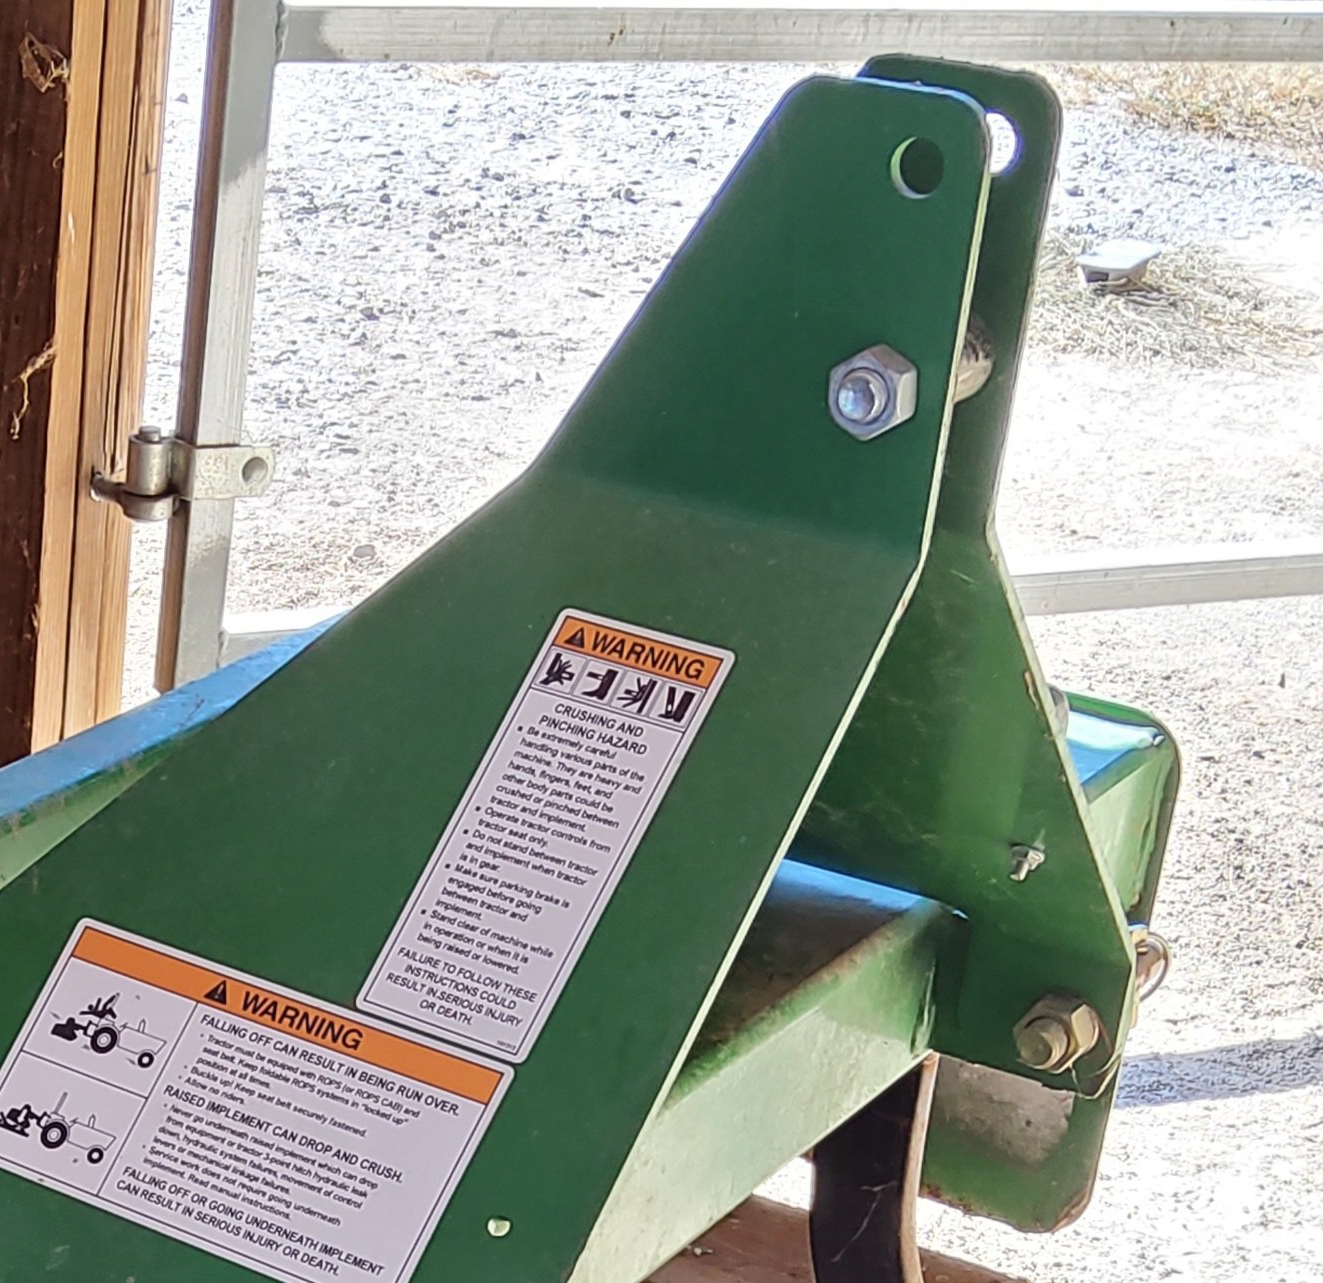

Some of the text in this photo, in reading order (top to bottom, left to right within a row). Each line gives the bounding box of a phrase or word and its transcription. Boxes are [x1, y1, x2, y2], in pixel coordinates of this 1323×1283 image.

[591, 630, 706, 681] WARNING
[538, 714, 648, 755] PINCHING HAZARD
[554, 703, 644, 738] CRUSHING AND
[385, 972, 524, 1027] RESULT IN SERIOUS INJURY
[397, 946, 538, 1003] FAILURE TO FOLLOW THESE
[404, 963, 517, 1010] INSTRUCTIONS COULD
[241, 990, 364, 1051] WARNING
[419, 999, 437, 1013] OR
[199, 1013, 249, 1039] FALLING
[248, 1031, 274, 1047] OFF
[272, 1040, 300, 1058] CAN
[298, 1049, 346, 1074] RESULT
[343, 1065, 359, 1079] IN
[357, 1070, 397, 1092] BEING
[395, 1084, 424, 1103] RUN
[163, 1084, 206, 1108] RAISED
[205, 1100, 273, 1133] IMPLEMENT
[272, 1125, 299, 1143] CAN
[297, 1135, 333, 1155] DROP
[330, 1148, 359, 1166] AND
[116, 1179, 141, 1196] CAN
[139, 1188, 183, 1213] RESULT
[180, 1205, 195, 1218] IN
[193, 1210, 243, 1237] SERIOUS
[241, 1229, 284, 1252] INJURY
[282, 1245, 301, 1261] OR
[122, 1166, 385, 1276] FALLING OFF OR GOING UNDERNEATH IMPLEMENT
